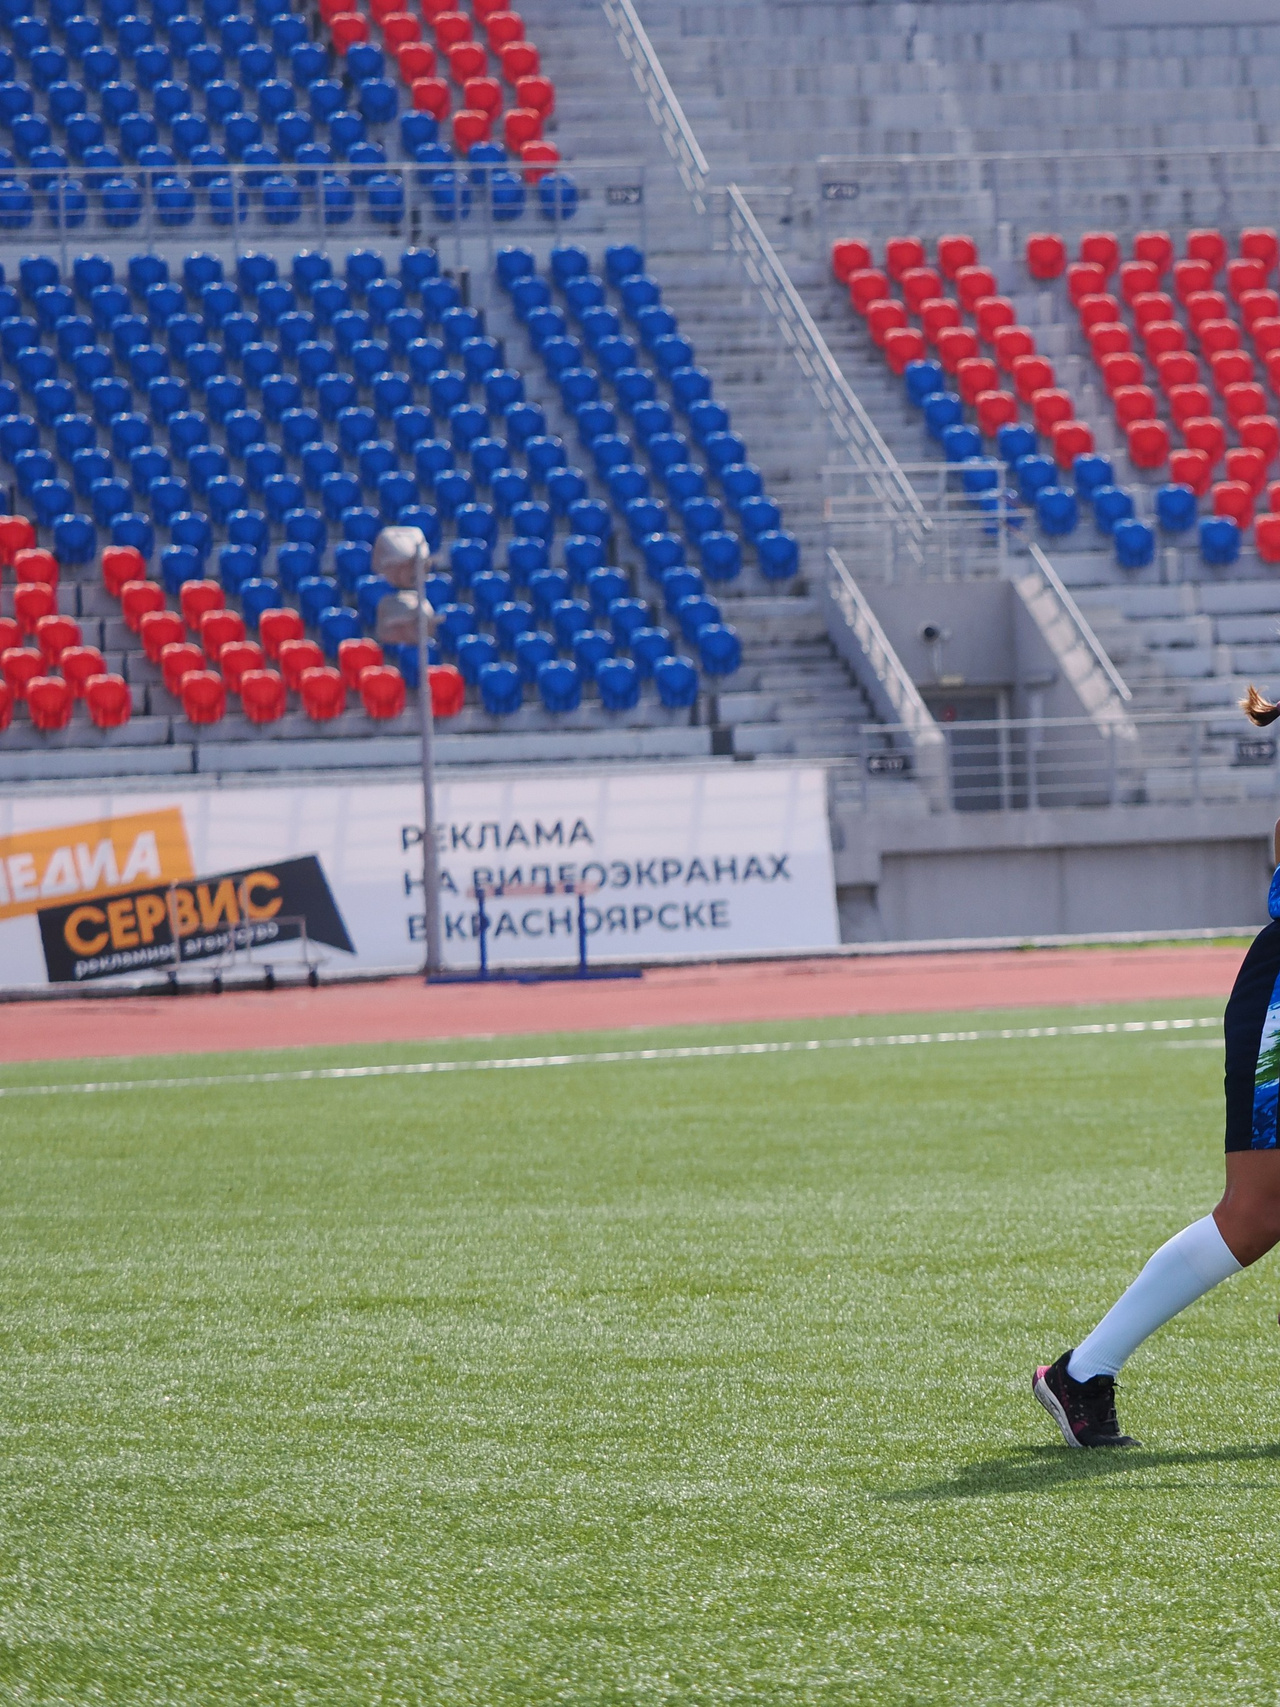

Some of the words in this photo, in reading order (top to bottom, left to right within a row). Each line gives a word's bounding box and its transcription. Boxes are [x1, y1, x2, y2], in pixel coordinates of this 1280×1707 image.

[402, 819, 594, 850] РЕКЛАМА
[0, 830, 162, 905] ЕДИА
[404, 868, 458, 896] НА
[473, 853, 792, 894] ВИДЕОЭКРАНАХ
[64, 871, 283, 956] СЕРВИС
[445, 899, 731, 939] КРАСНОЯРСКЕ
